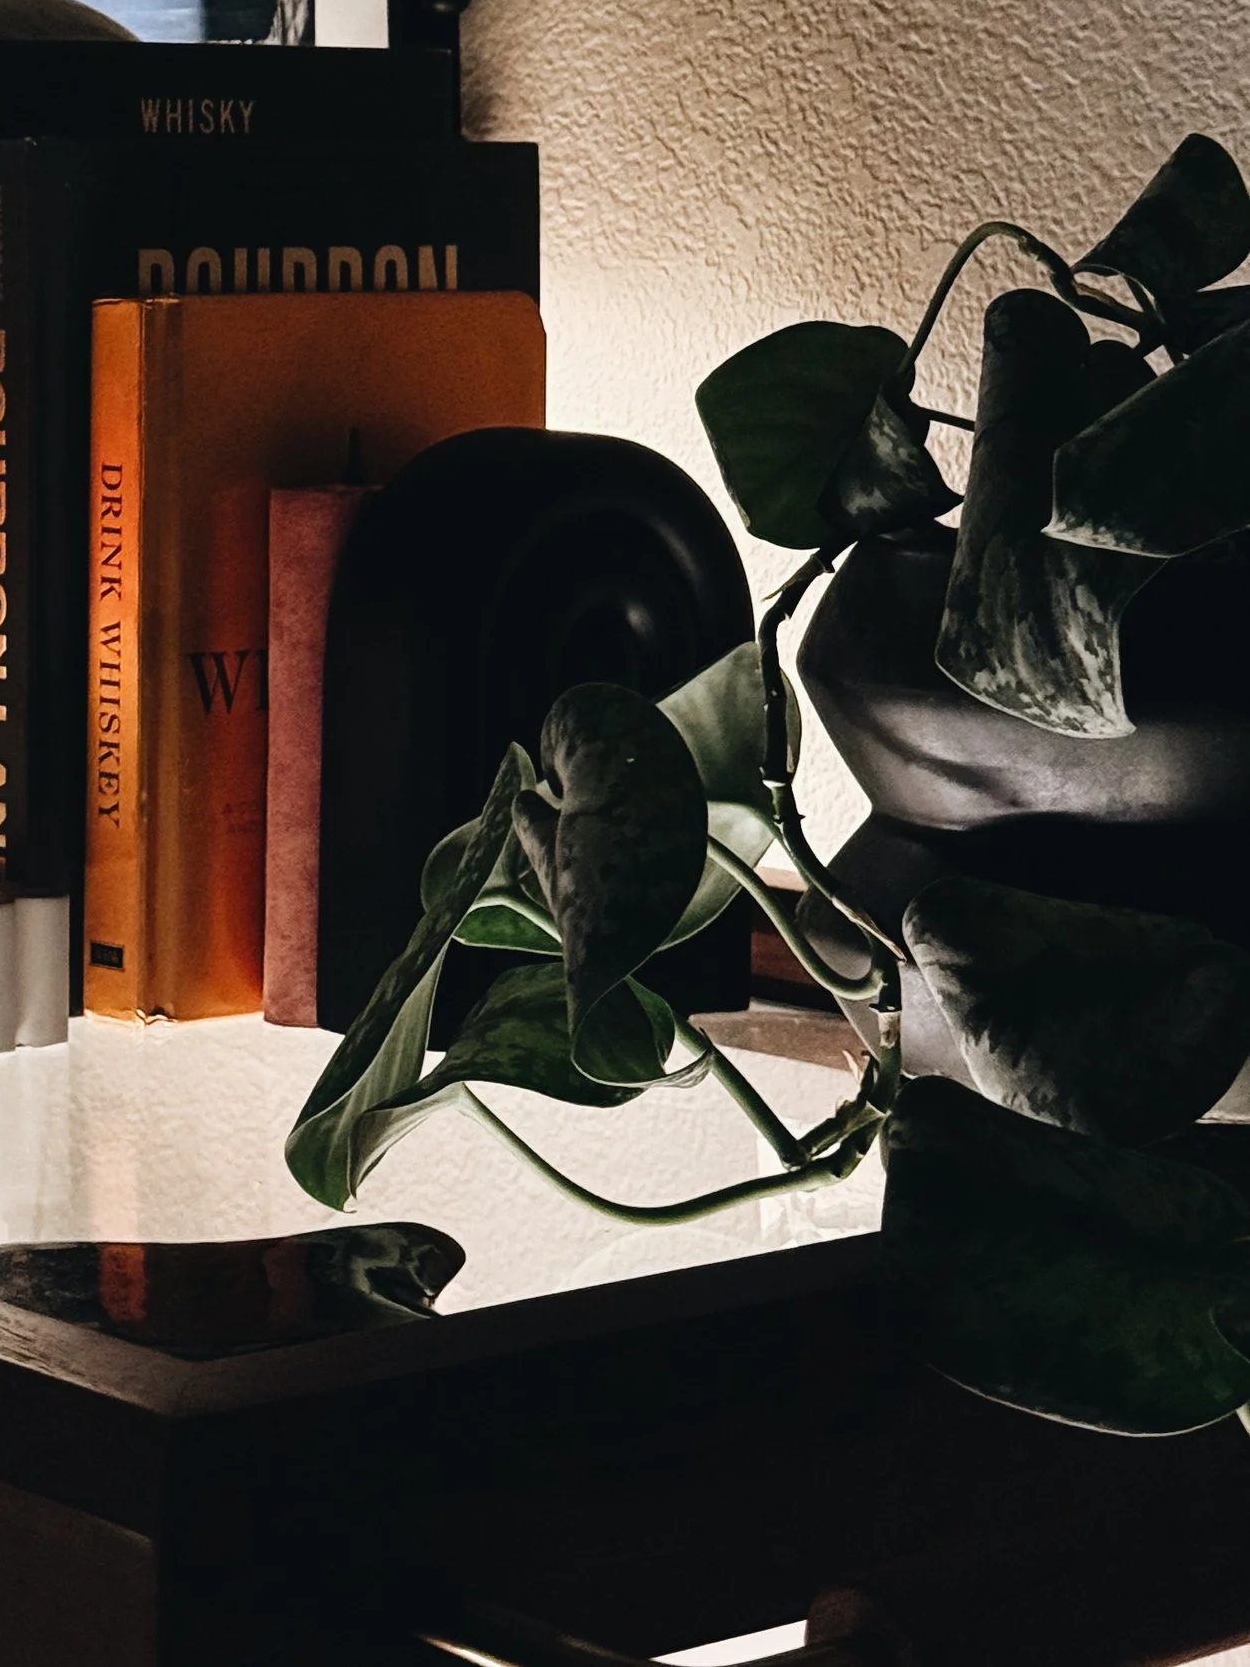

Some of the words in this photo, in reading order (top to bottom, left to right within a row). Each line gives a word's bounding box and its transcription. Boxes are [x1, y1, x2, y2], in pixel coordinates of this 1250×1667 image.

[141, 98, 255, 135] WHISKY
[99, 464, 123, 601] DRINK
[97, 622, 122, 828] WHISKEY
